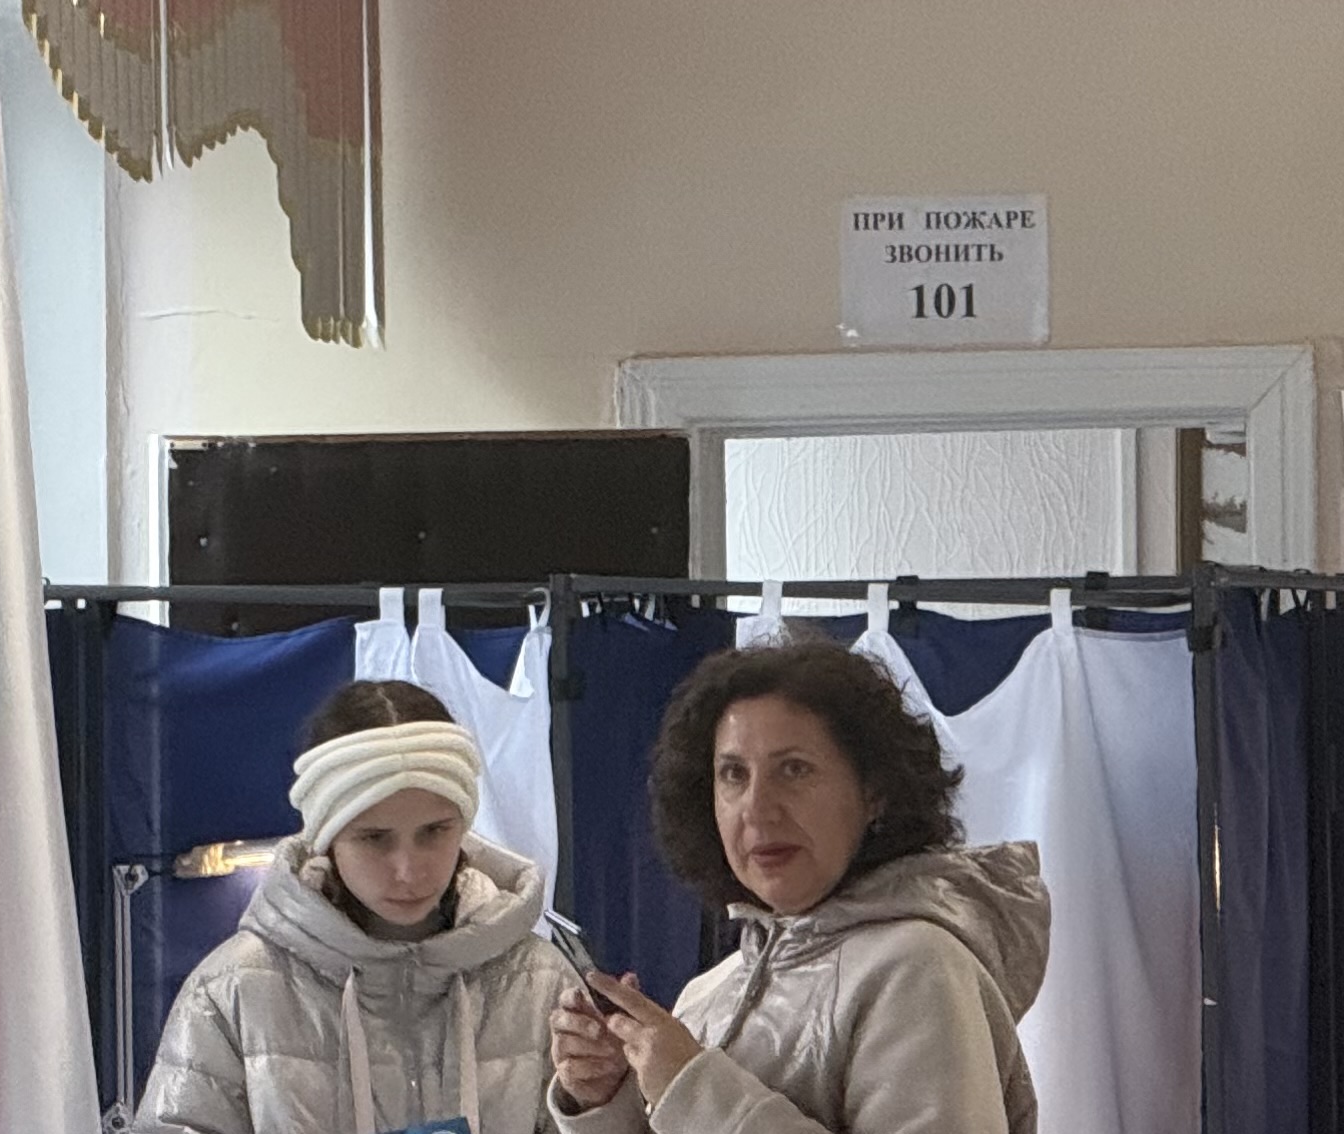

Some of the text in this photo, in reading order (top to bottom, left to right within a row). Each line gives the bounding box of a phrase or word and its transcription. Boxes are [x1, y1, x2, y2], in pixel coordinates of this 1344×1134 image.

[853, 210, 1036, 231] ПРИ ПОЖАРЕ
[884, 243, 1004, 263] ЗВОНИТЬ
[910, 282, 977, 319] 101
